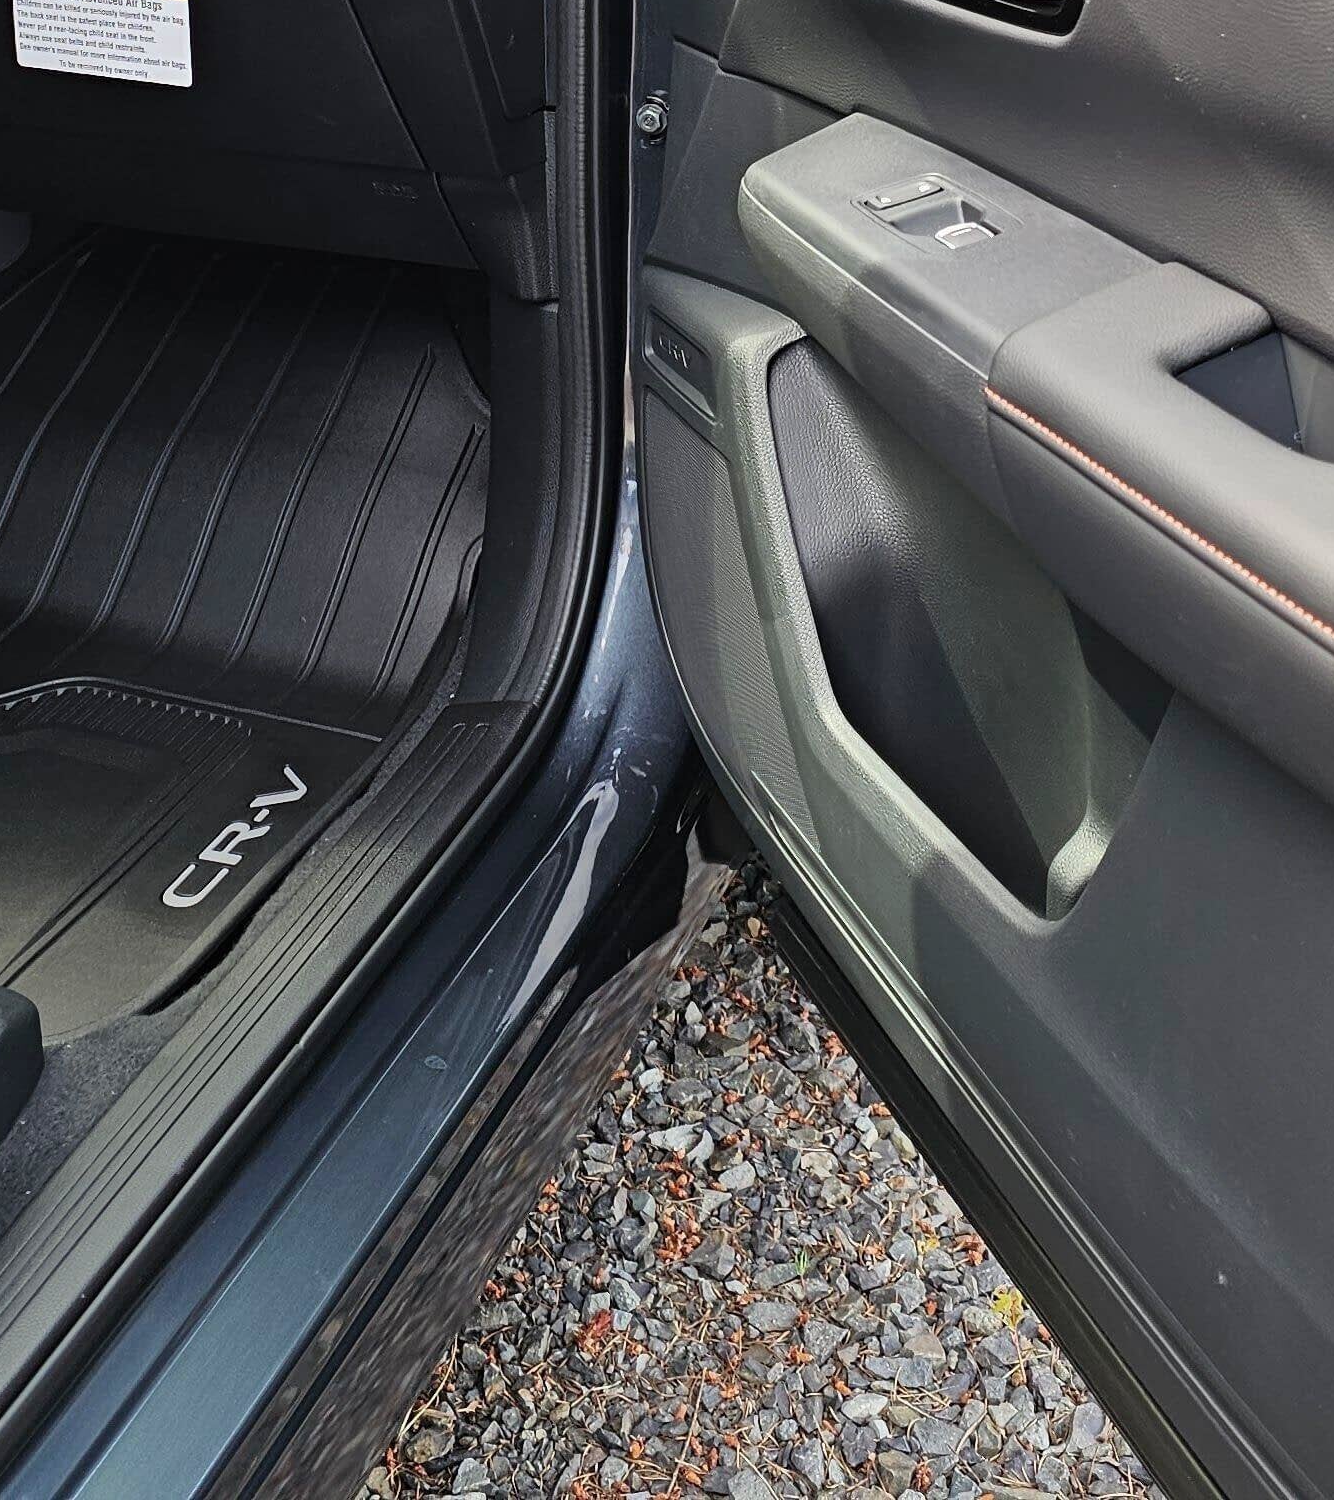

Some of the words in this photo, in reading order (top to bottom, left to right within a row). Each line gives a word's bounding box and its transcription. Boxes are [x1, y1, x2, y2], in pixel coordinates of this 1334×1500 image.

[142, 13, 149, 22] by
[88, 30, 104, 38] child
[163, 765, 307, 908] CR-V
